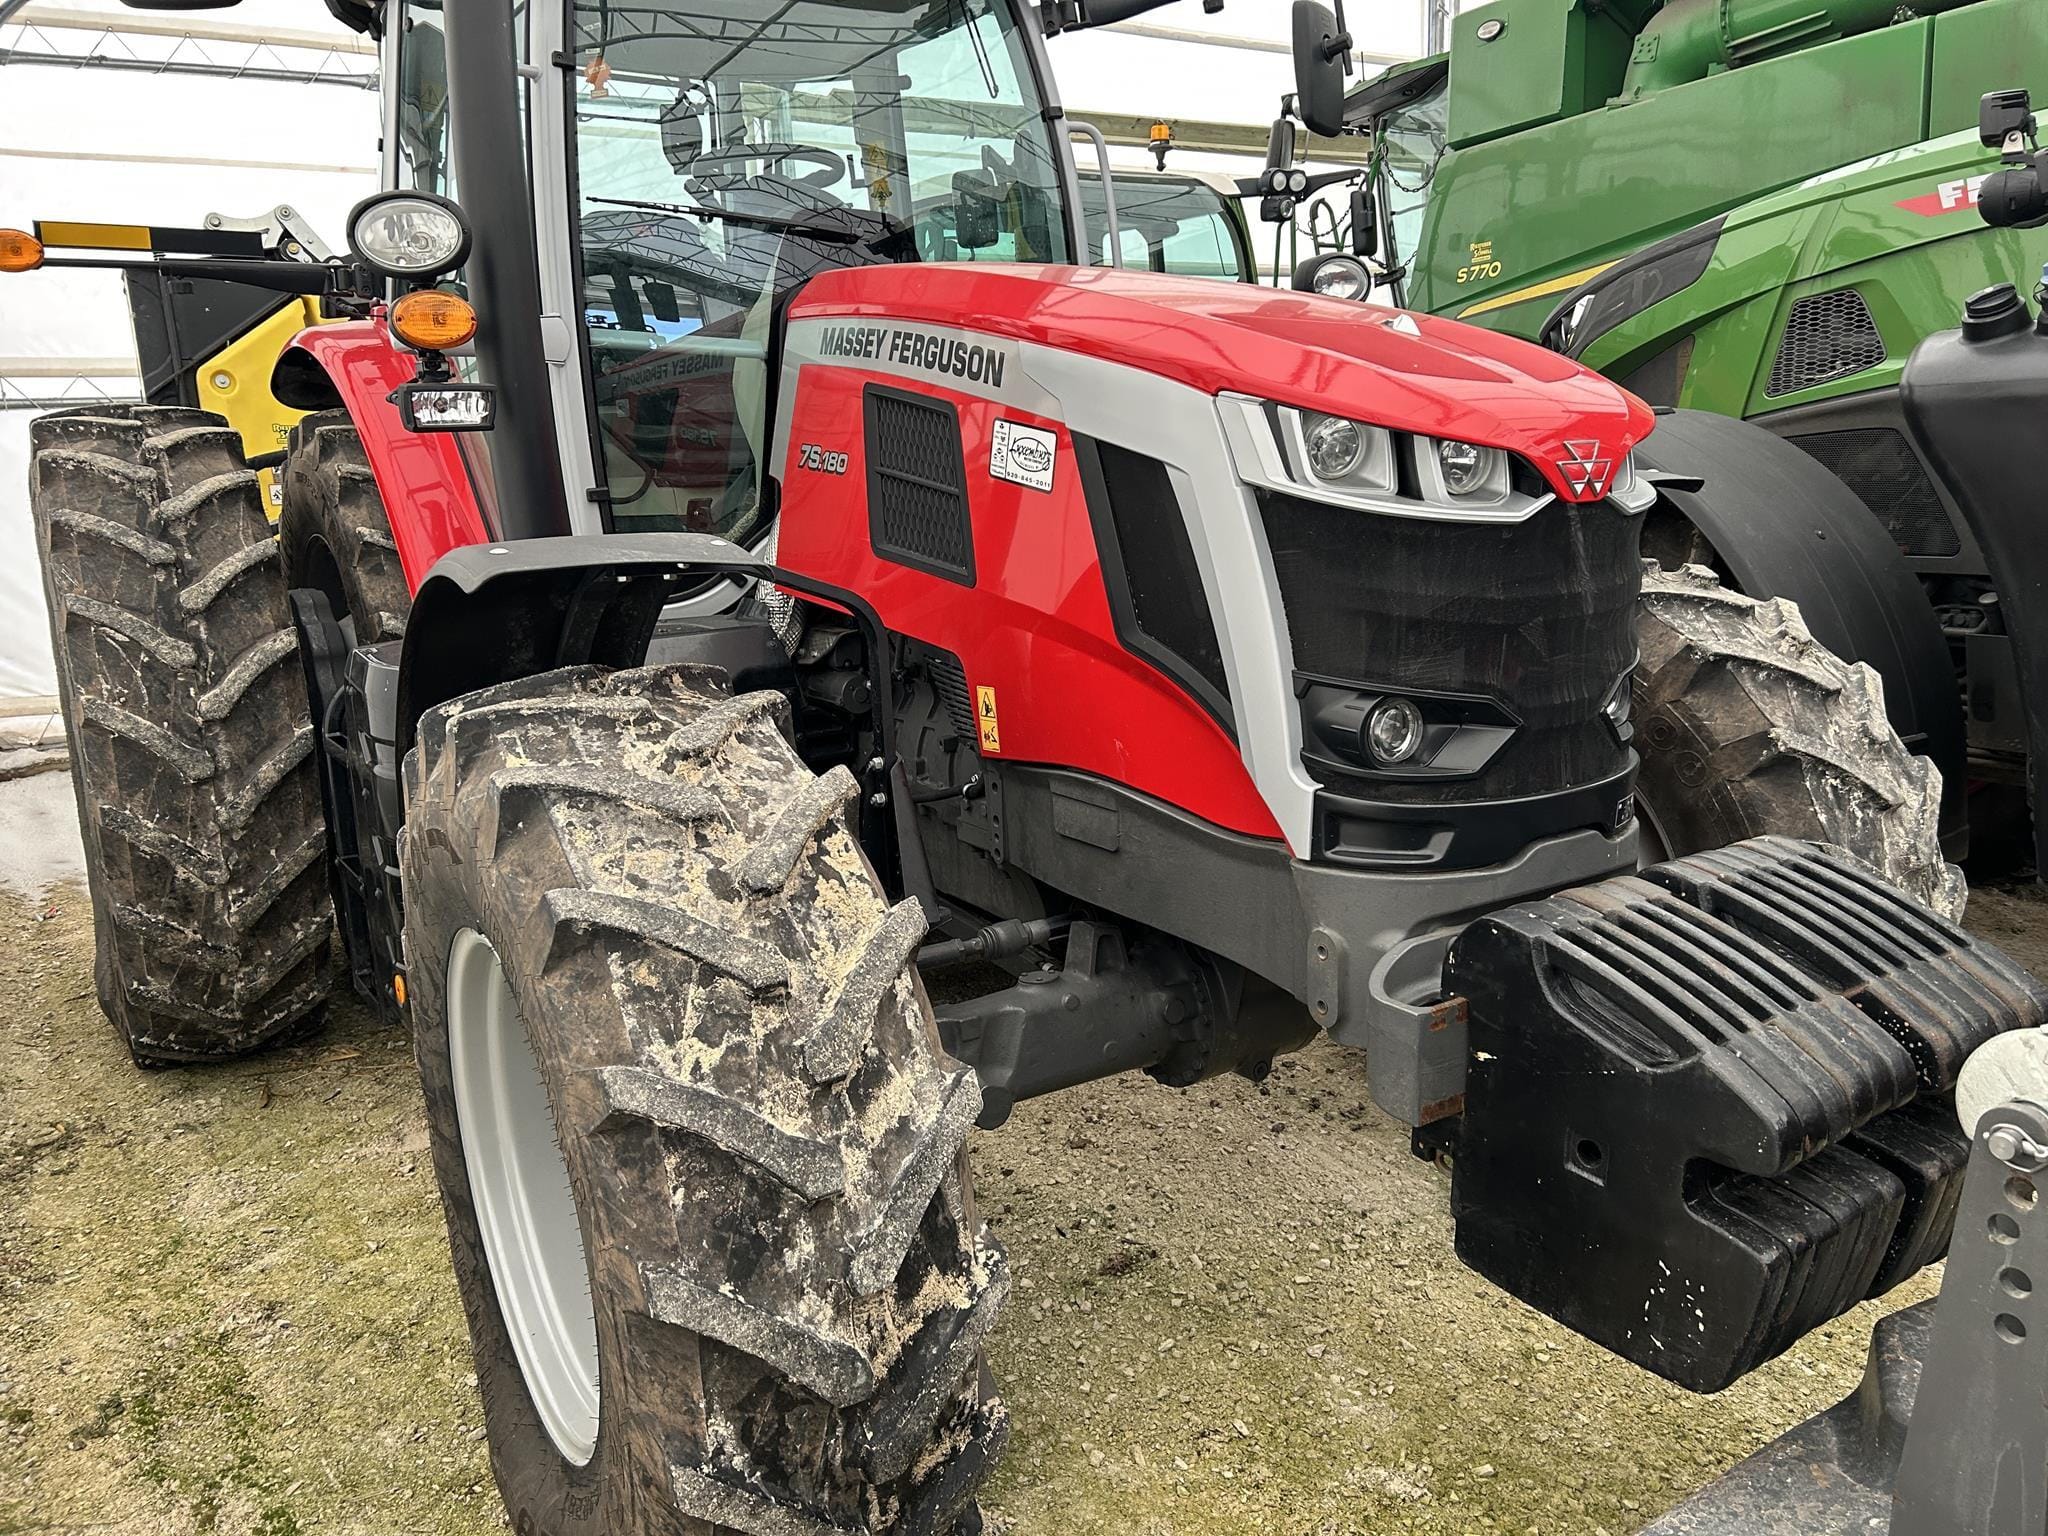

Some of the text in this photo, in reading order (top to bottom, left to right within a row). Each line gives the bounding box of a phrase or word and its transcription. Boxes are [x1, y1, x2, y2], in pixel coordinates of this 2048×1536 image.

[1456, 260, 1502, 283] S770
[819, 327, 1006, 388] MASSEY FERGUSON
[798, 443, 849, 474] 7S.180
[1006, 471, 1051, 488] 920-845-2011
